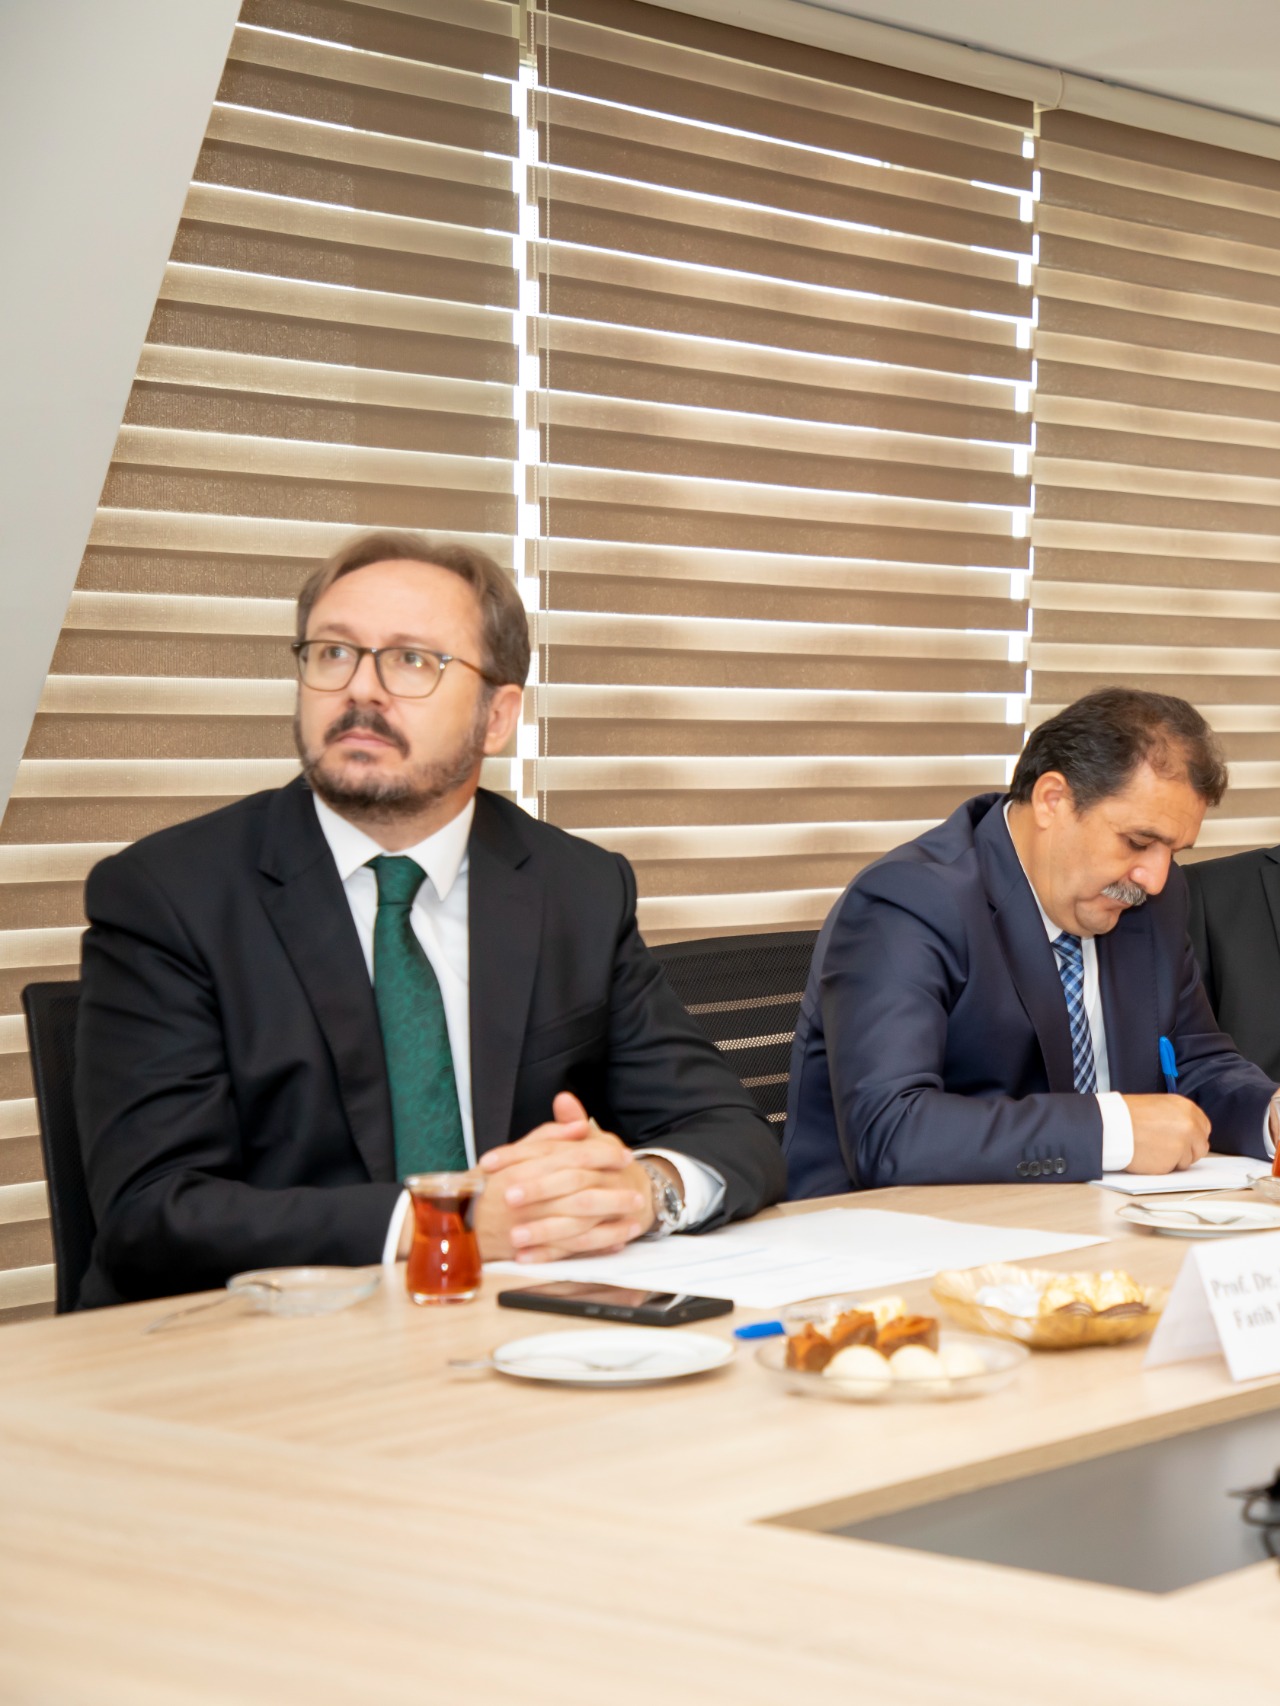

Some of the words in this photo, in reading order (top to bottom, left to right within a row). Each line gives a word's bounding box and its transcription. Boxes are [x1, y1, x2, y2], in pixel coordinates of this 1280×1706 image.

[1211, 1275, 1251, 1299] Prof.
[1253, 1272, 1278, 1291] Dr.
[1233, 1302, 1275, 1330] Fatih
